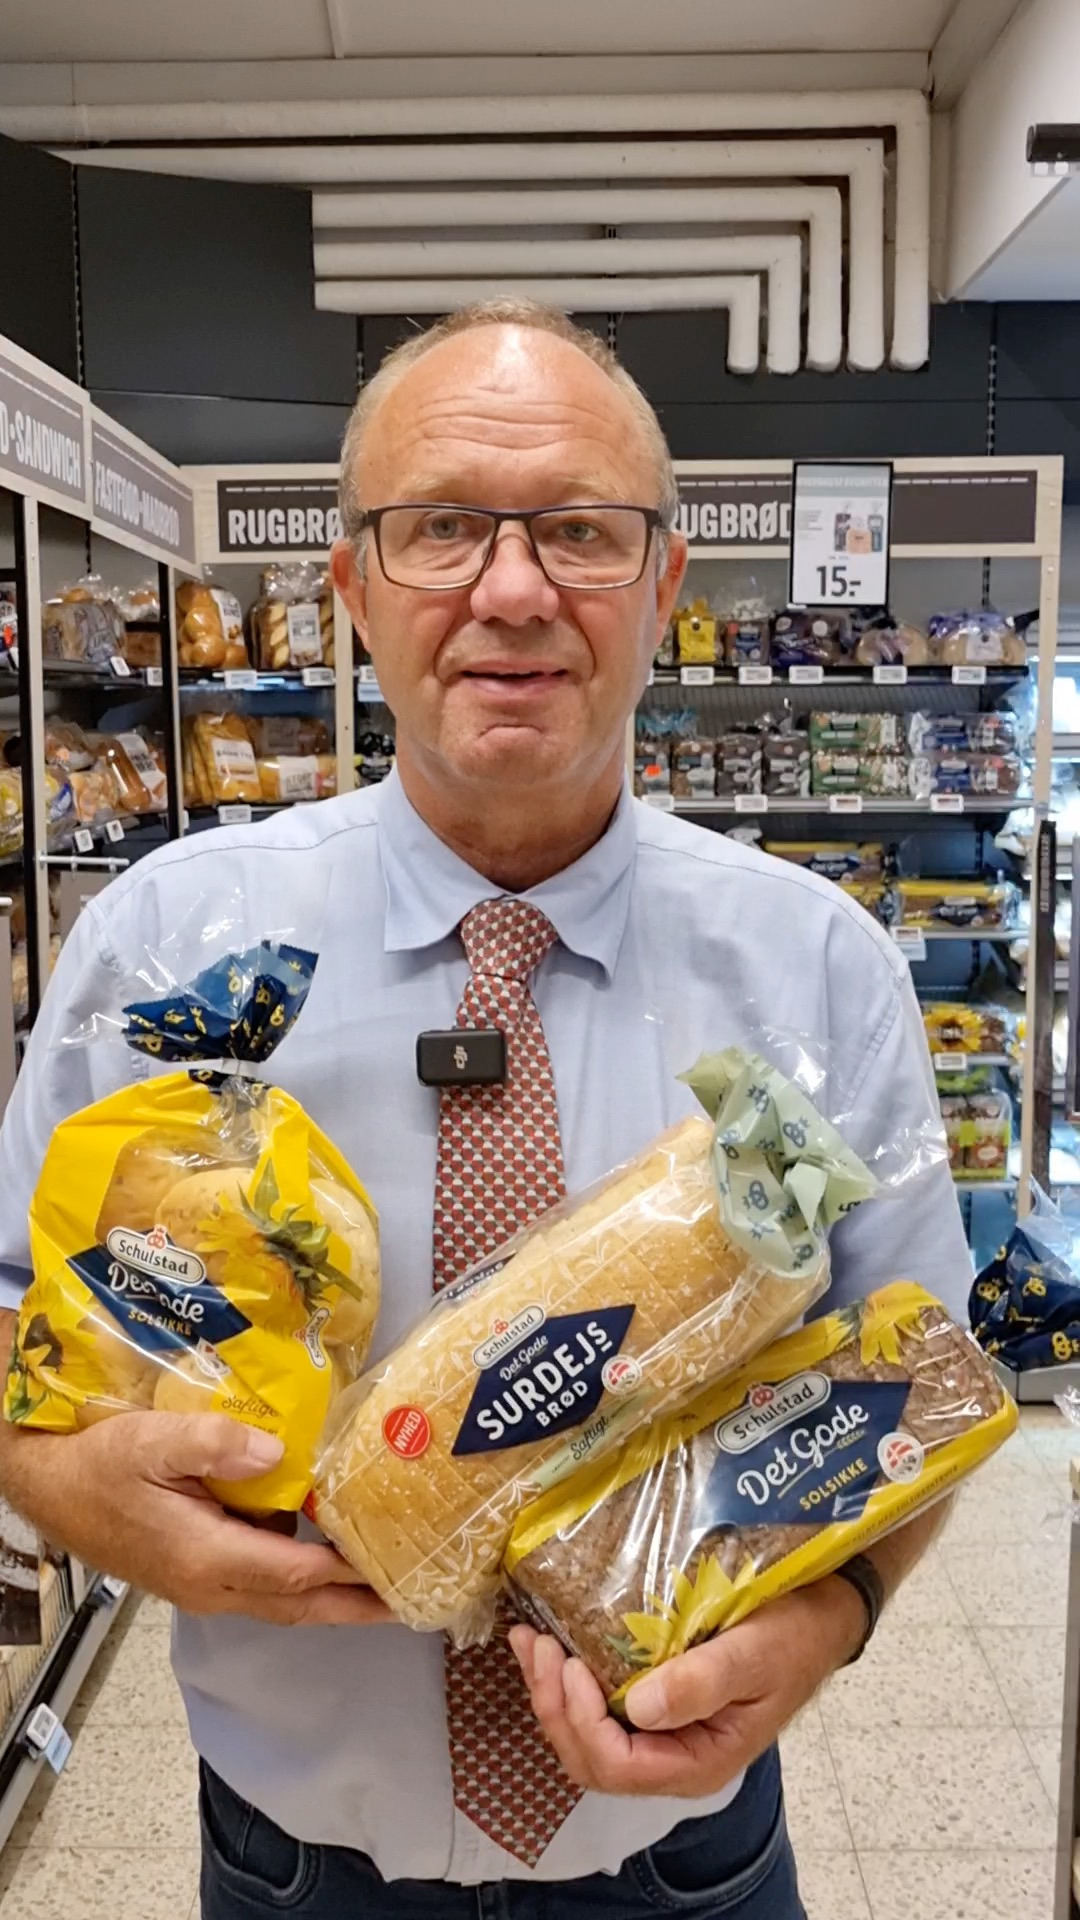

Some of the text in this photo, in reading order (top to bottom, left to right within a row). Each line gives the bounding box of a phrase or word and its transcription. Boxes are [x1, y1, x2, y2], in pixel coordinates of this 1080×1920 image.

[228, 507, 344, 545] RUGBRØ
[118, 1239, 189, 1276] Schulstad
[482, 1314, 536, 1361] Schulstad
[500, 1335, 549, 1381] Det Gode
[476, 1321, 608, 1441] SURDEJS
[535, 1380, 588, 1427] BRØD
[393, 1411, 421, 1452] NYHED
[733, 1382, 815, 1440] Schulstad
[737, 1446, 797, 1506] Det
[790, 1404, 869, 1468] Gode
[799, 1457, 868, 1511] SOLSIKKE
